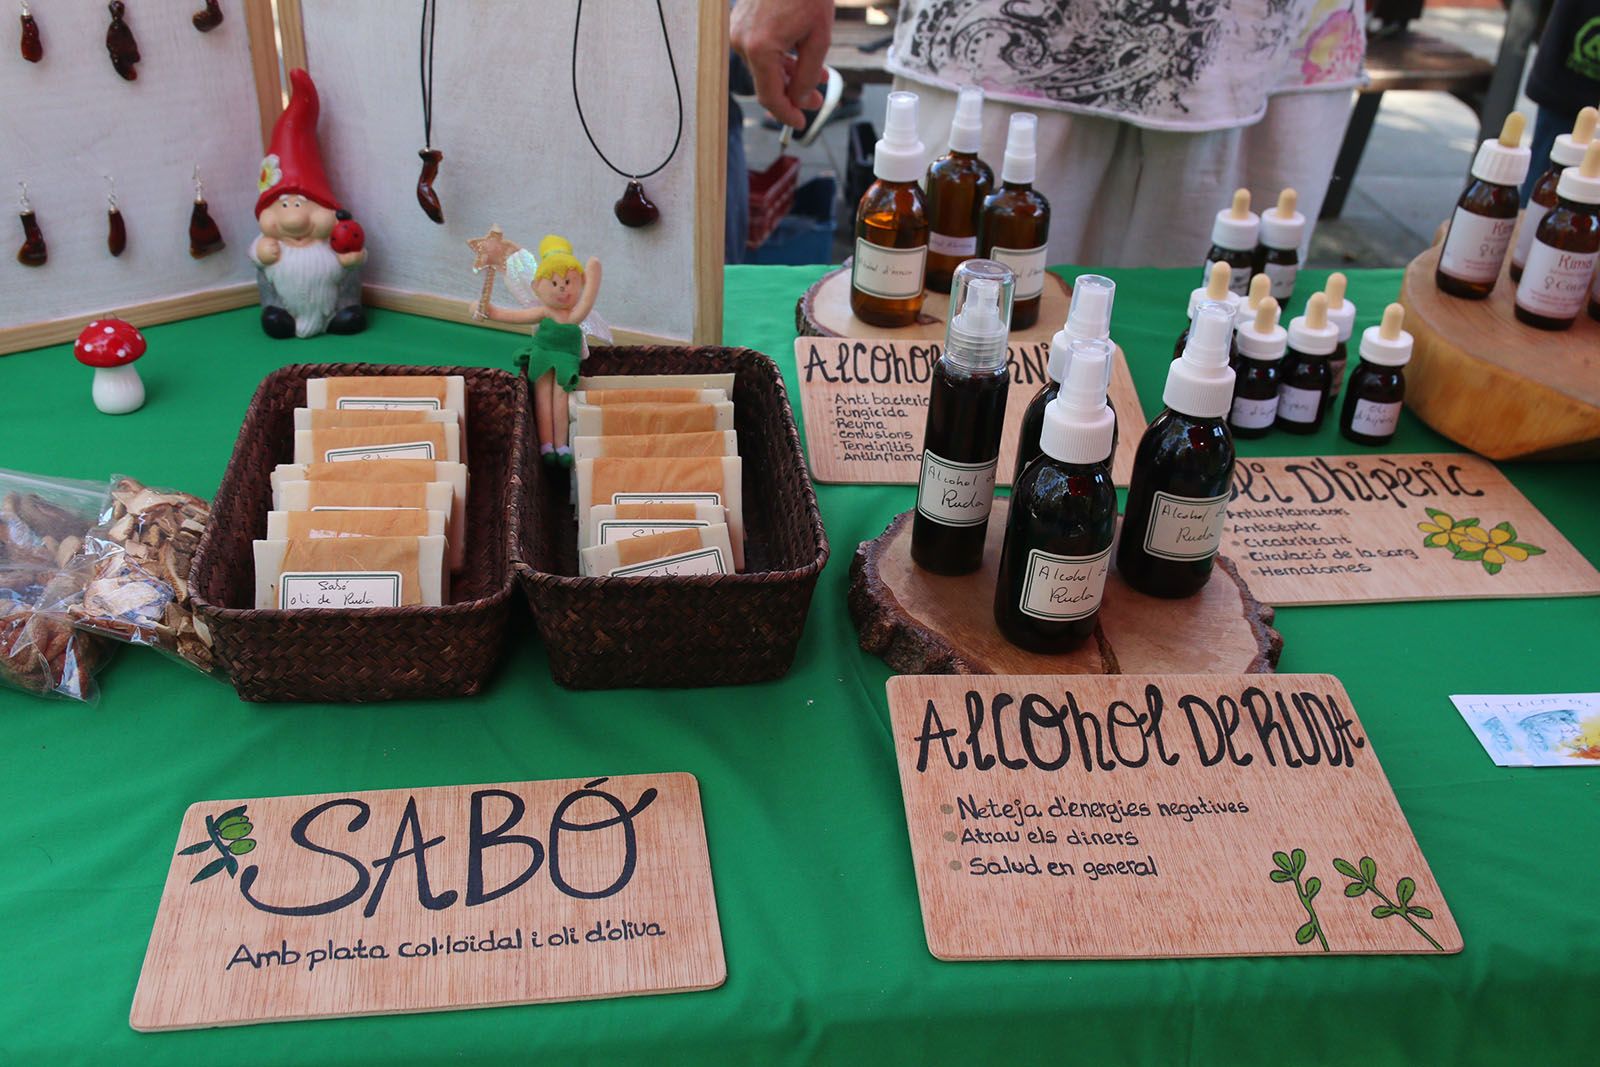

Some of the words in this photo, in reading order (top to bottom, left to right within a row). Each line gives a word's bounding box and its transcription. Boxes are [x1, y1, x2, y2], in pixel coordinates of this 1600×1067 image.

[835, 406, 909, 420] Fungicida
[835, 418, 887, 430] Reuma
[840, 440, 915, 453] Tendinitis
[928, 465, 978, 486] Alcohol
[941, 488, 985, 509] Ruda
[1161, 504, 1208, 522] Alcohol
[1244, 535, 1353, 549] Cicatritzant
[1249, 548, 1326, 562] Circulació
[1332, 548, 1353, 559] de
[1359, 547, 1376, 558] la
[1038, 565, 1093, 581] Alcohol
[1258, 562, 1372, 577] Hematomes
[290, 592, 310, 606] oli
[317, 592, 331, 605] de
[343, 591, 374, 606] Ruda
[1049, 586, 1094, 604] Ruda
[1240, 686, 1365, 769] RUDA
[956, 796, 1043, 826] Neteja
[1047, 796, 1152, 822] d'energies
[1156, 799, 1250, 823] negatives
[959, 828, 1020, 845] Atrau
[1027, 826, 1058, 845] els
[1066, 828, 1139, 846] diners
[239, 776, 659, 919] SABÓ
[969, 856, 1042, 877] Salud
[1047, 859, 1076, 877] en
[1082, 855, 1158, 881] general
[225, 939, 301, 971] Amb
[306, 937, 390, 972] plata
[530, 929, 544, 947] i
[547, 926, 578, 947] oli
[584, 920, 667, 943] d'oliva
